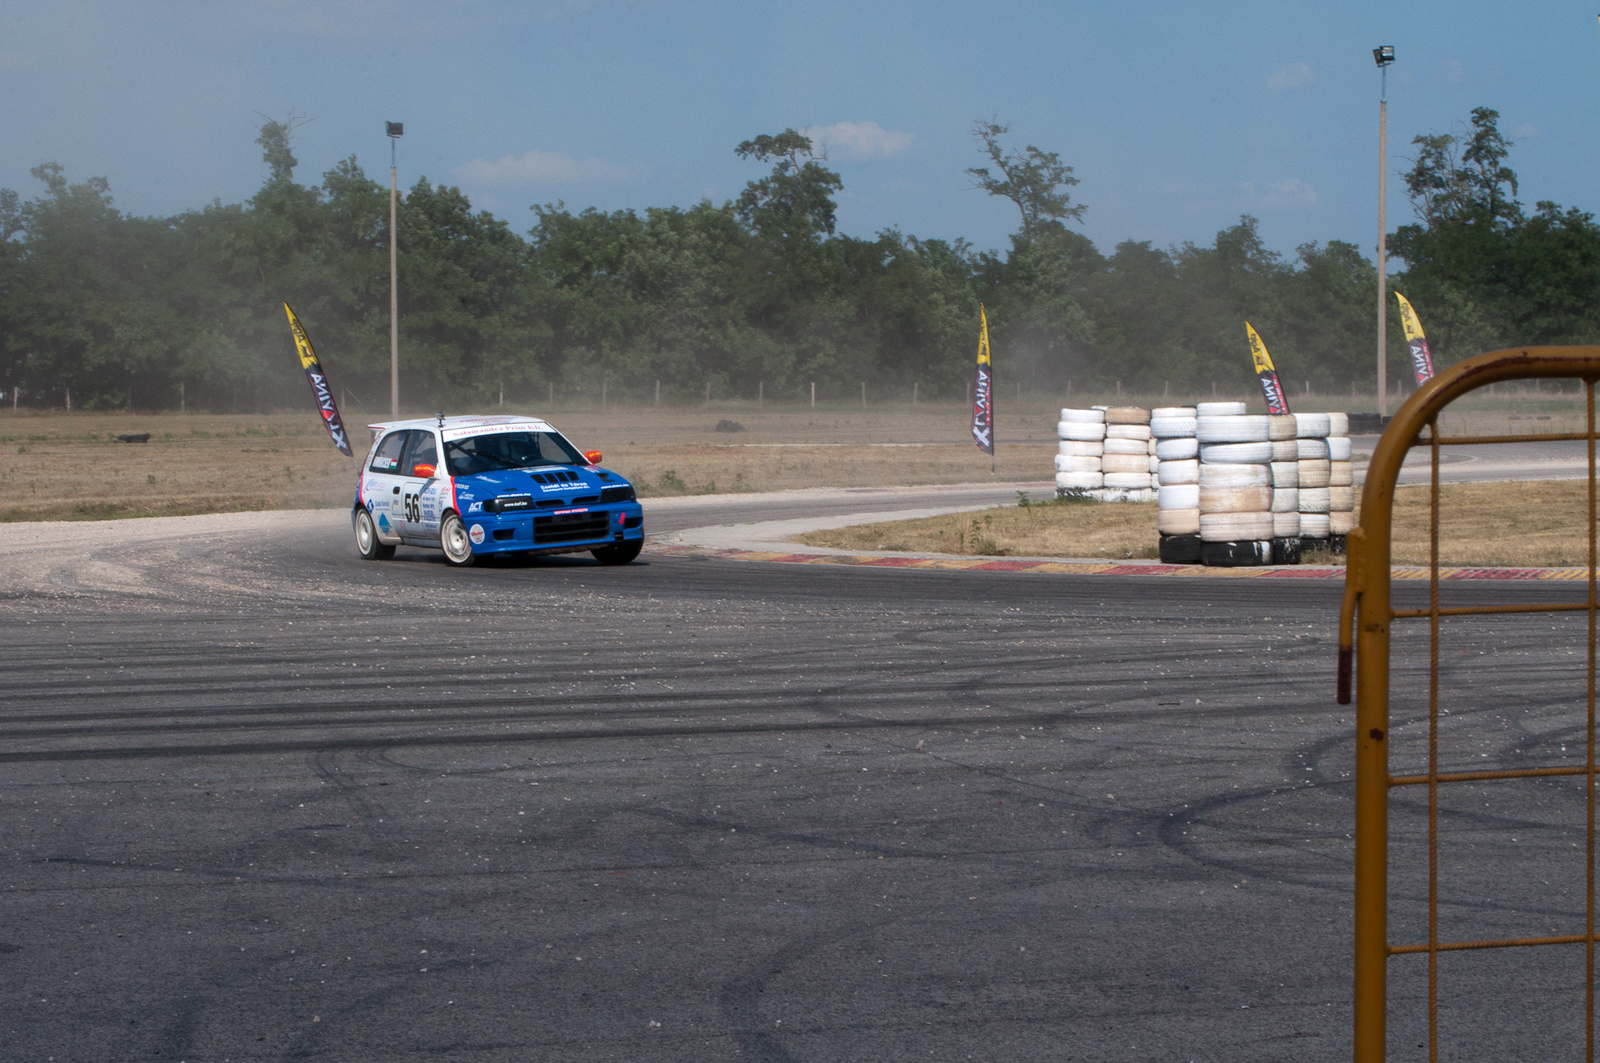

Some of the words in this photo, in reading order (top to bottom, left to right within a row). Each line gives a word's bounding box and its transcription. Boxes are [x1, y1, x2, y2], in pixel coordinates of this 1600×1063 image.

[453, 426, 503, 437] Salamandra
[404, 493, 420, 524] 56
[468, 501, 483, 512] ACT
